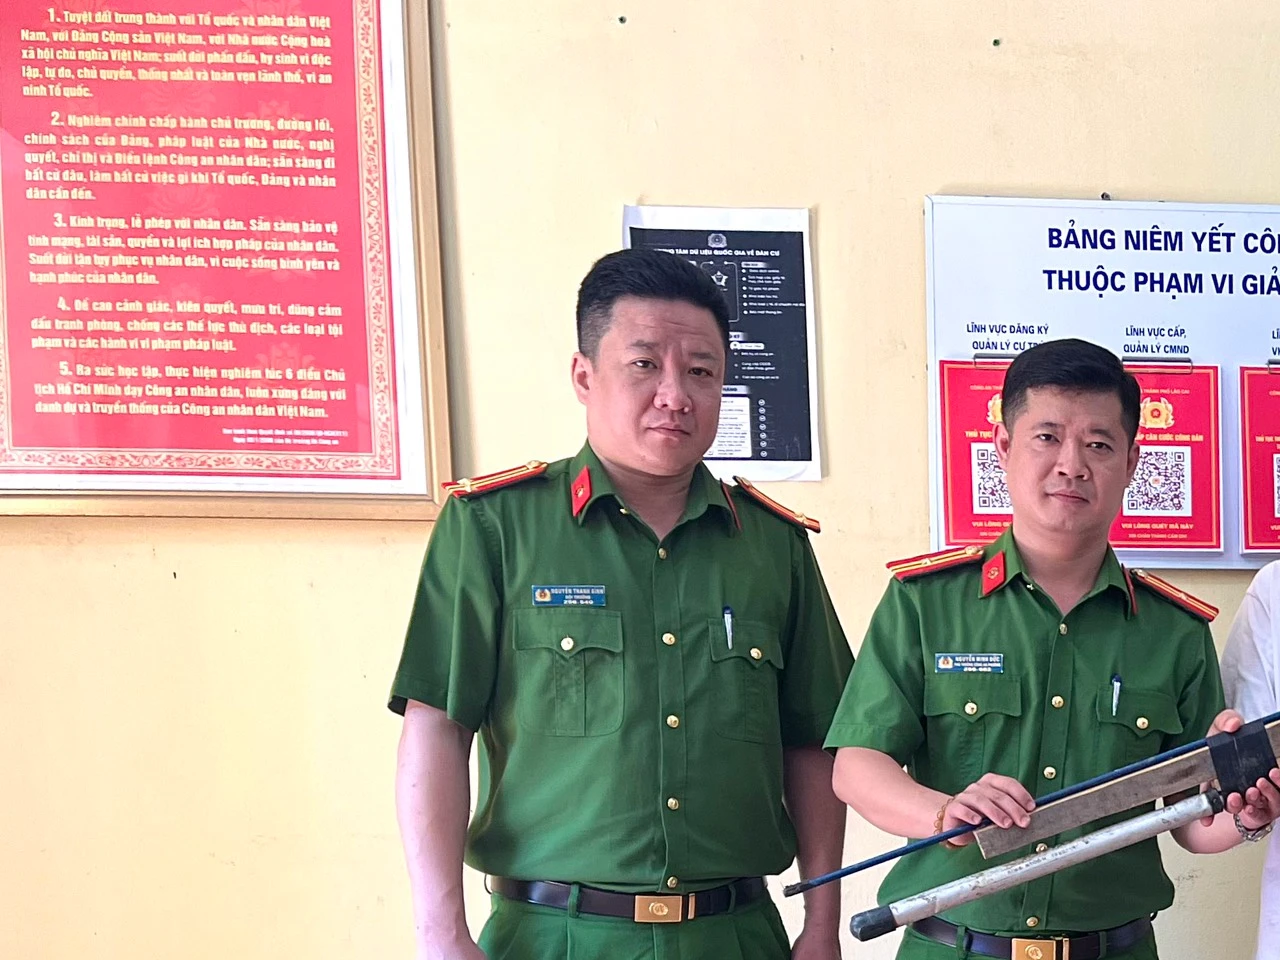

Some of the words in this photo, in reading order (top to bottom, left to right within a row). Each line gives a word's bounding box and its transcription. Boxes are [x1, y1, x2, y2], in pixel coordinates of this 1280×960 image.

[1048, 220, 1116, 250] BẢNG
[1124, 225, 1183, 252] NIÊM
[1192, 223, 1236, 253] YẾT
[1042, 265, 1126, 298] THUỘC
[1134, 271, 1204, 300] PHẠM
[1211, 273, 1234, 295] VI
[966, 321, 986, 333] LĨNH
[988, 323, 1008, 336] VỰC
[1009, 322, 1035, 335] ĐĂNG
[1037, 323, 1049, 335] KÝ
[1125, 324, 1145, 337] LĨNH
[1147, 326, 1165, 340] VỰC
[972, 337, 998, 350] QUẢN
[1000, 339, 1011, 350] LÝ
[1013, 341, 1026, 351] CƯ
[1123, 340, 1149, 353] QUẢN
[1150, 342, 1162, 354] LÝ
[1163, 344, 1190, 354] CMND
